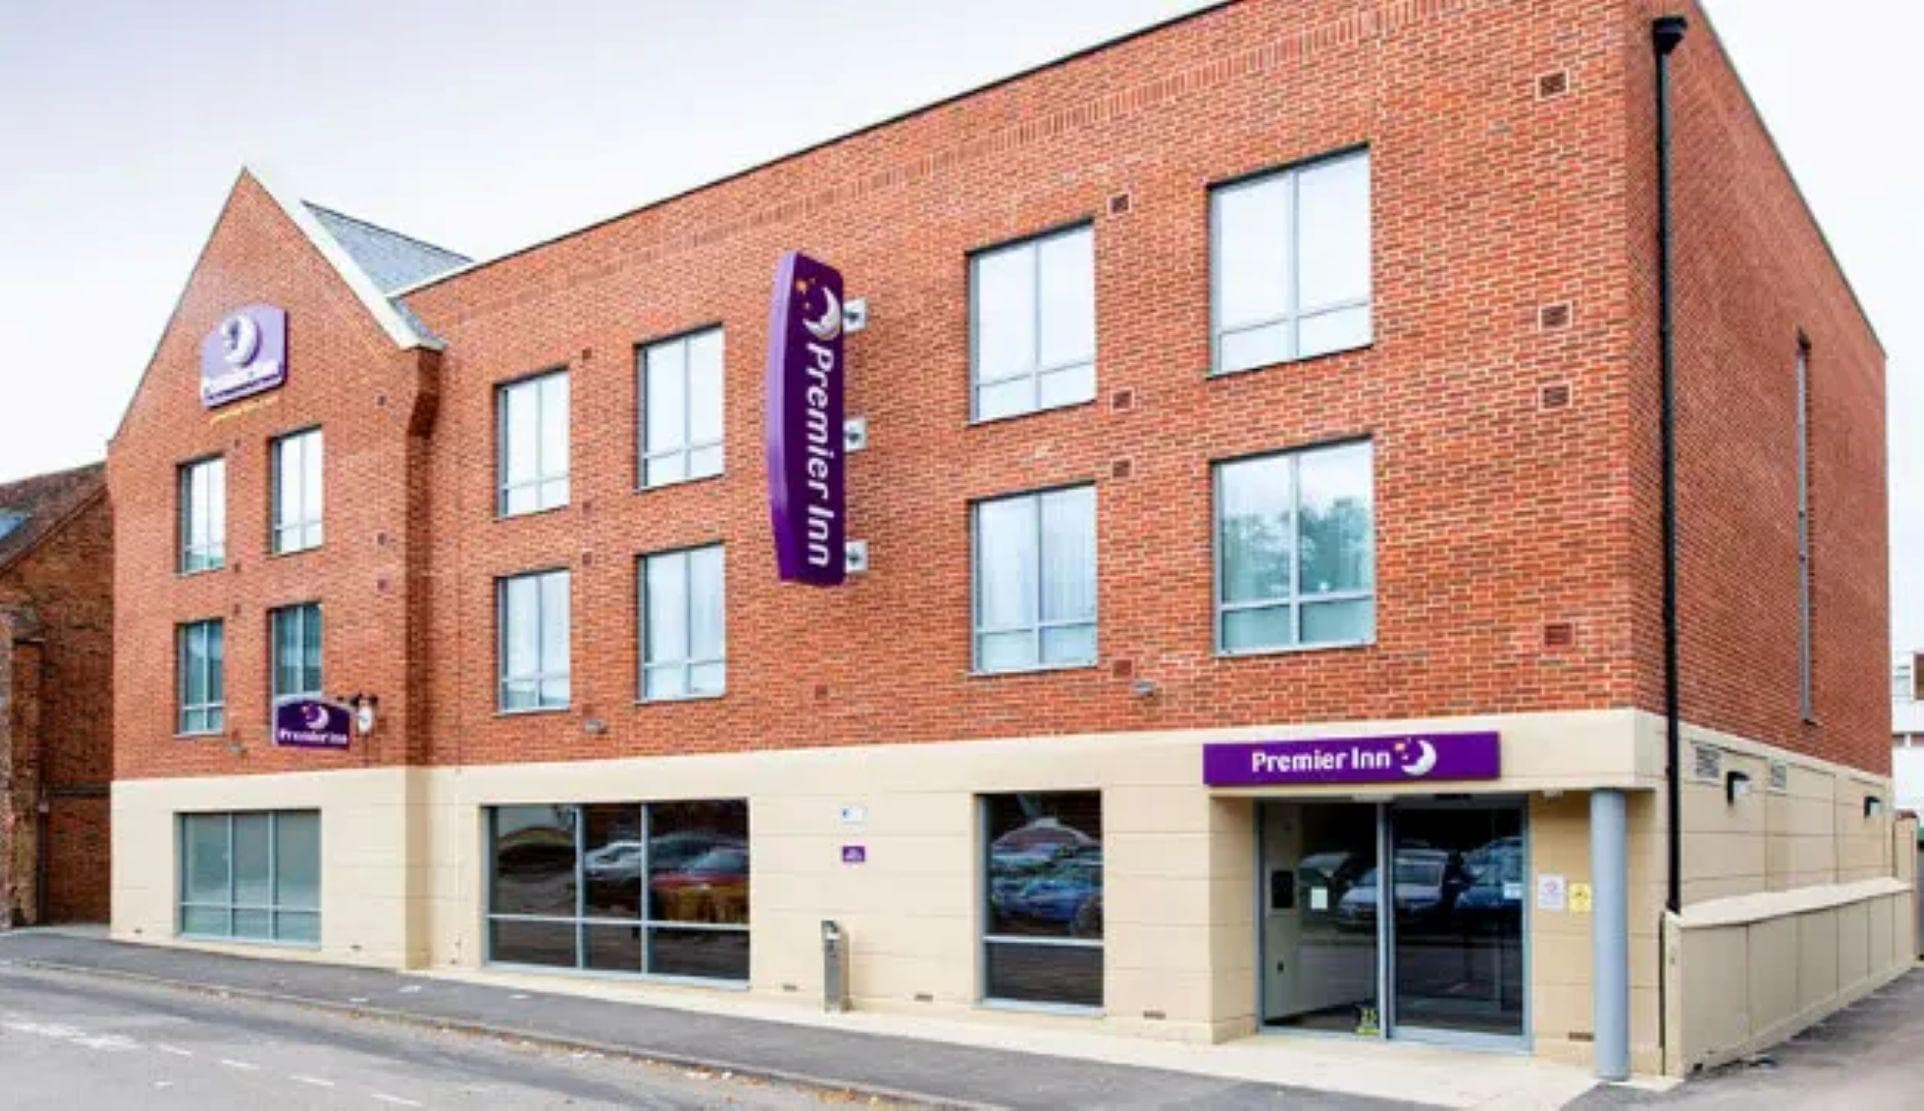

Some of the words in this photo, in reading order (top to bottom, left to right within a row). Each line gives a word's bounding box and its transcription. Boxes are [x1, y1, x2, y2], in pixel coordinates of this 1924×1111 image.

[806, 341, 834, 499] Premier
[807, 504, 834, 567] Inn
[1251, 748, 1348, 773] Premier
[1350, 746, 1391, 770] Inn
